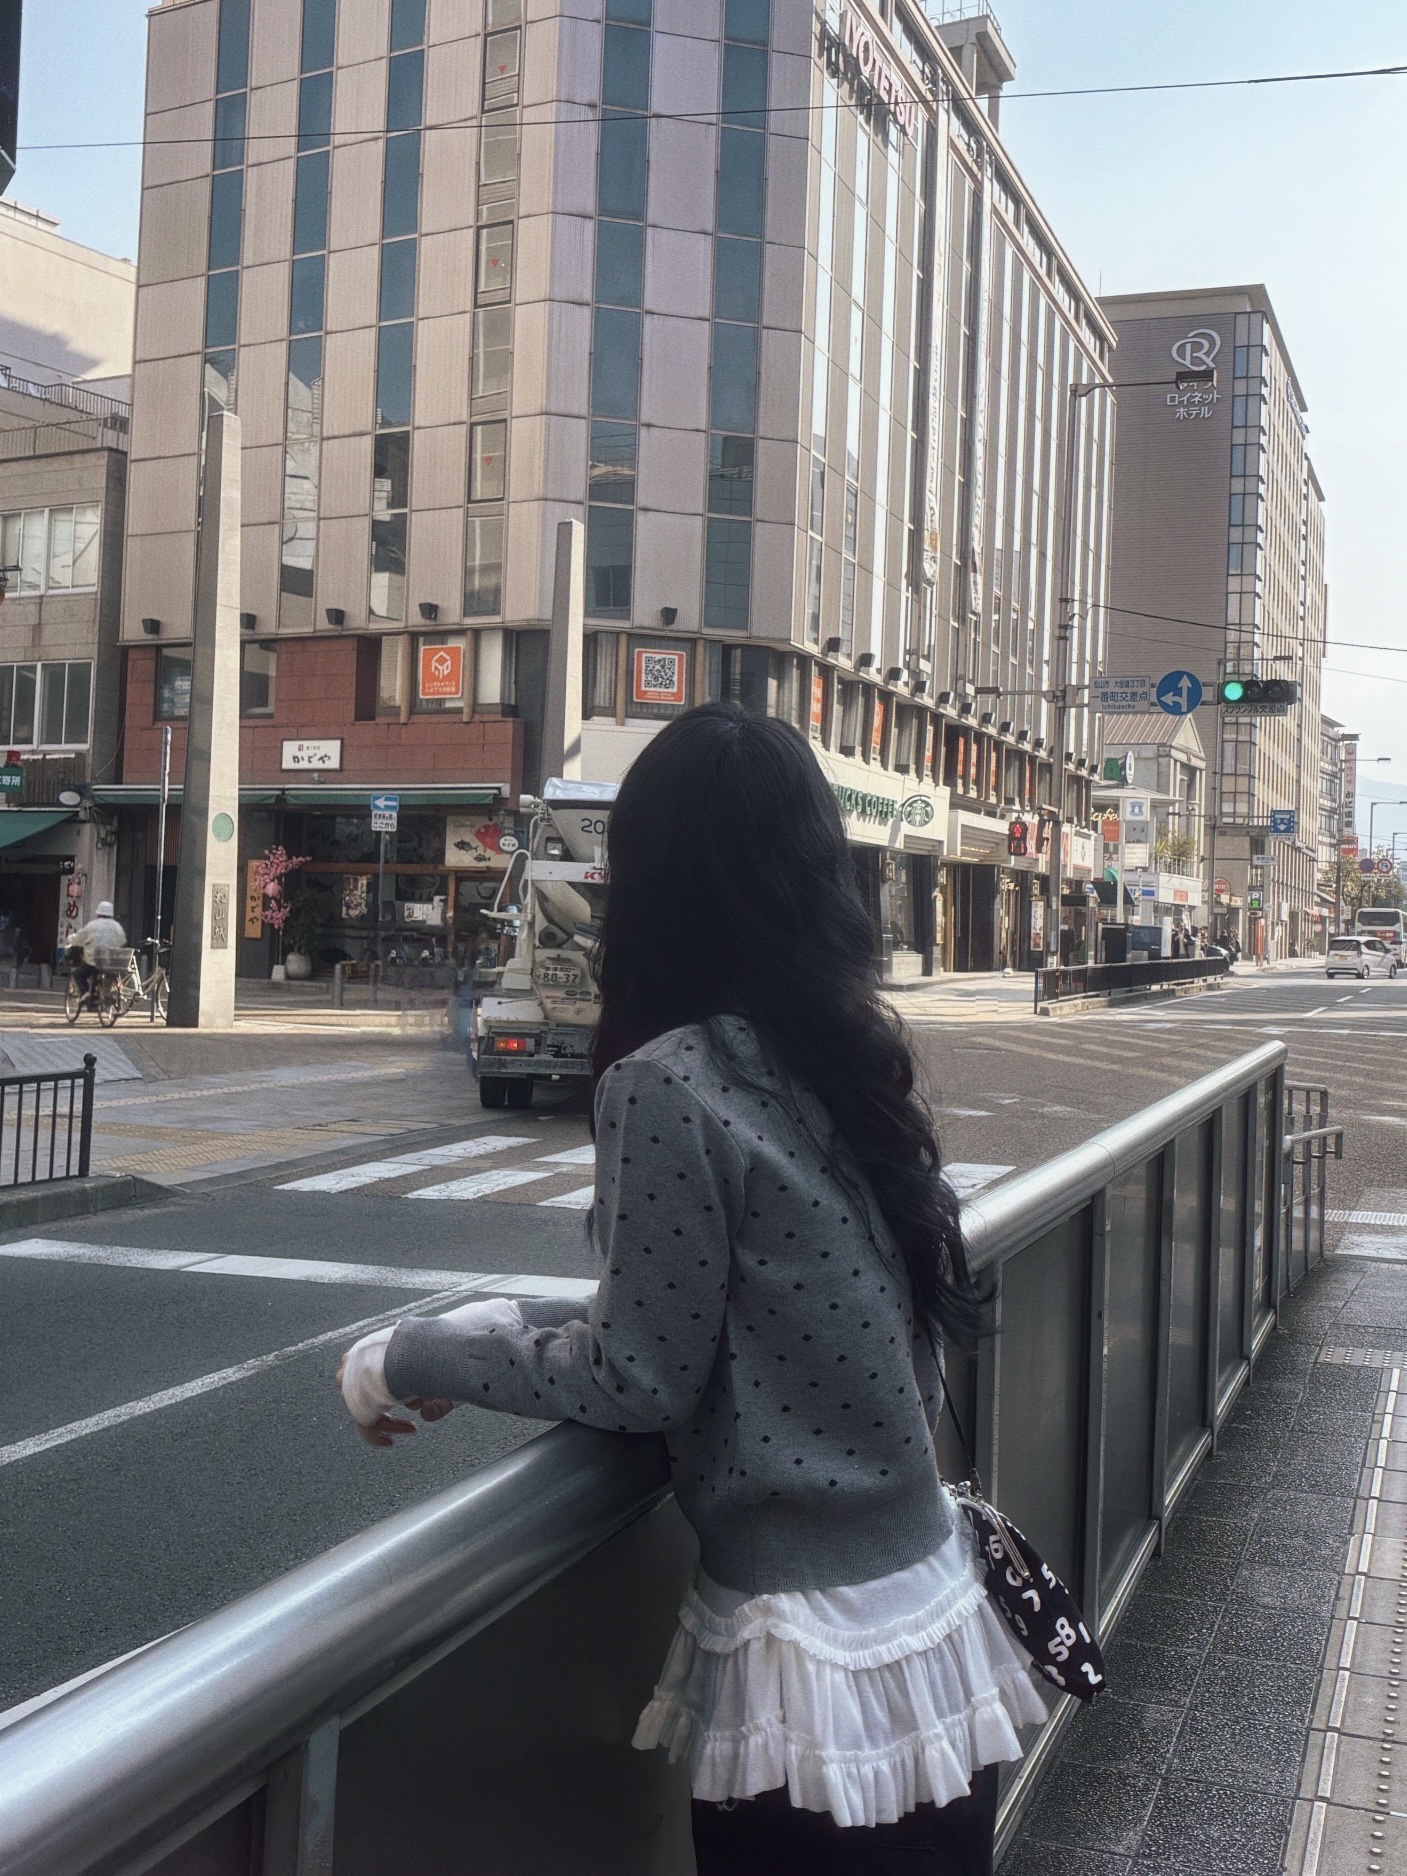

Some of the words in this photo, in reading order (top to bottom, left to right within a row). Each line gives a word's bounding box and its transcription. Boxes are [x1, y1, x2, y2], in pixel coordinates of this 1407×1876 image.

[840, 8, 919, 138] IYOTETSU
[1166, 391, 1222, 406] ロイネット
[1175, 406, 1213, 420] ホテル
[1090, 691, 1148, 703] 一番町交差点
[1223, 704, 1285, 714] スクランブル交差点
[292, 753, 331, 764] かどや
[865, 792, 898, 820] COFFEE
[1021, 1589, 1041, 1613] 7
[1055, 1616, 1076, 1647] 8
[1047, 1636, 1070, 1662] 5
[1080, 1662, 1103, 1685] 2
